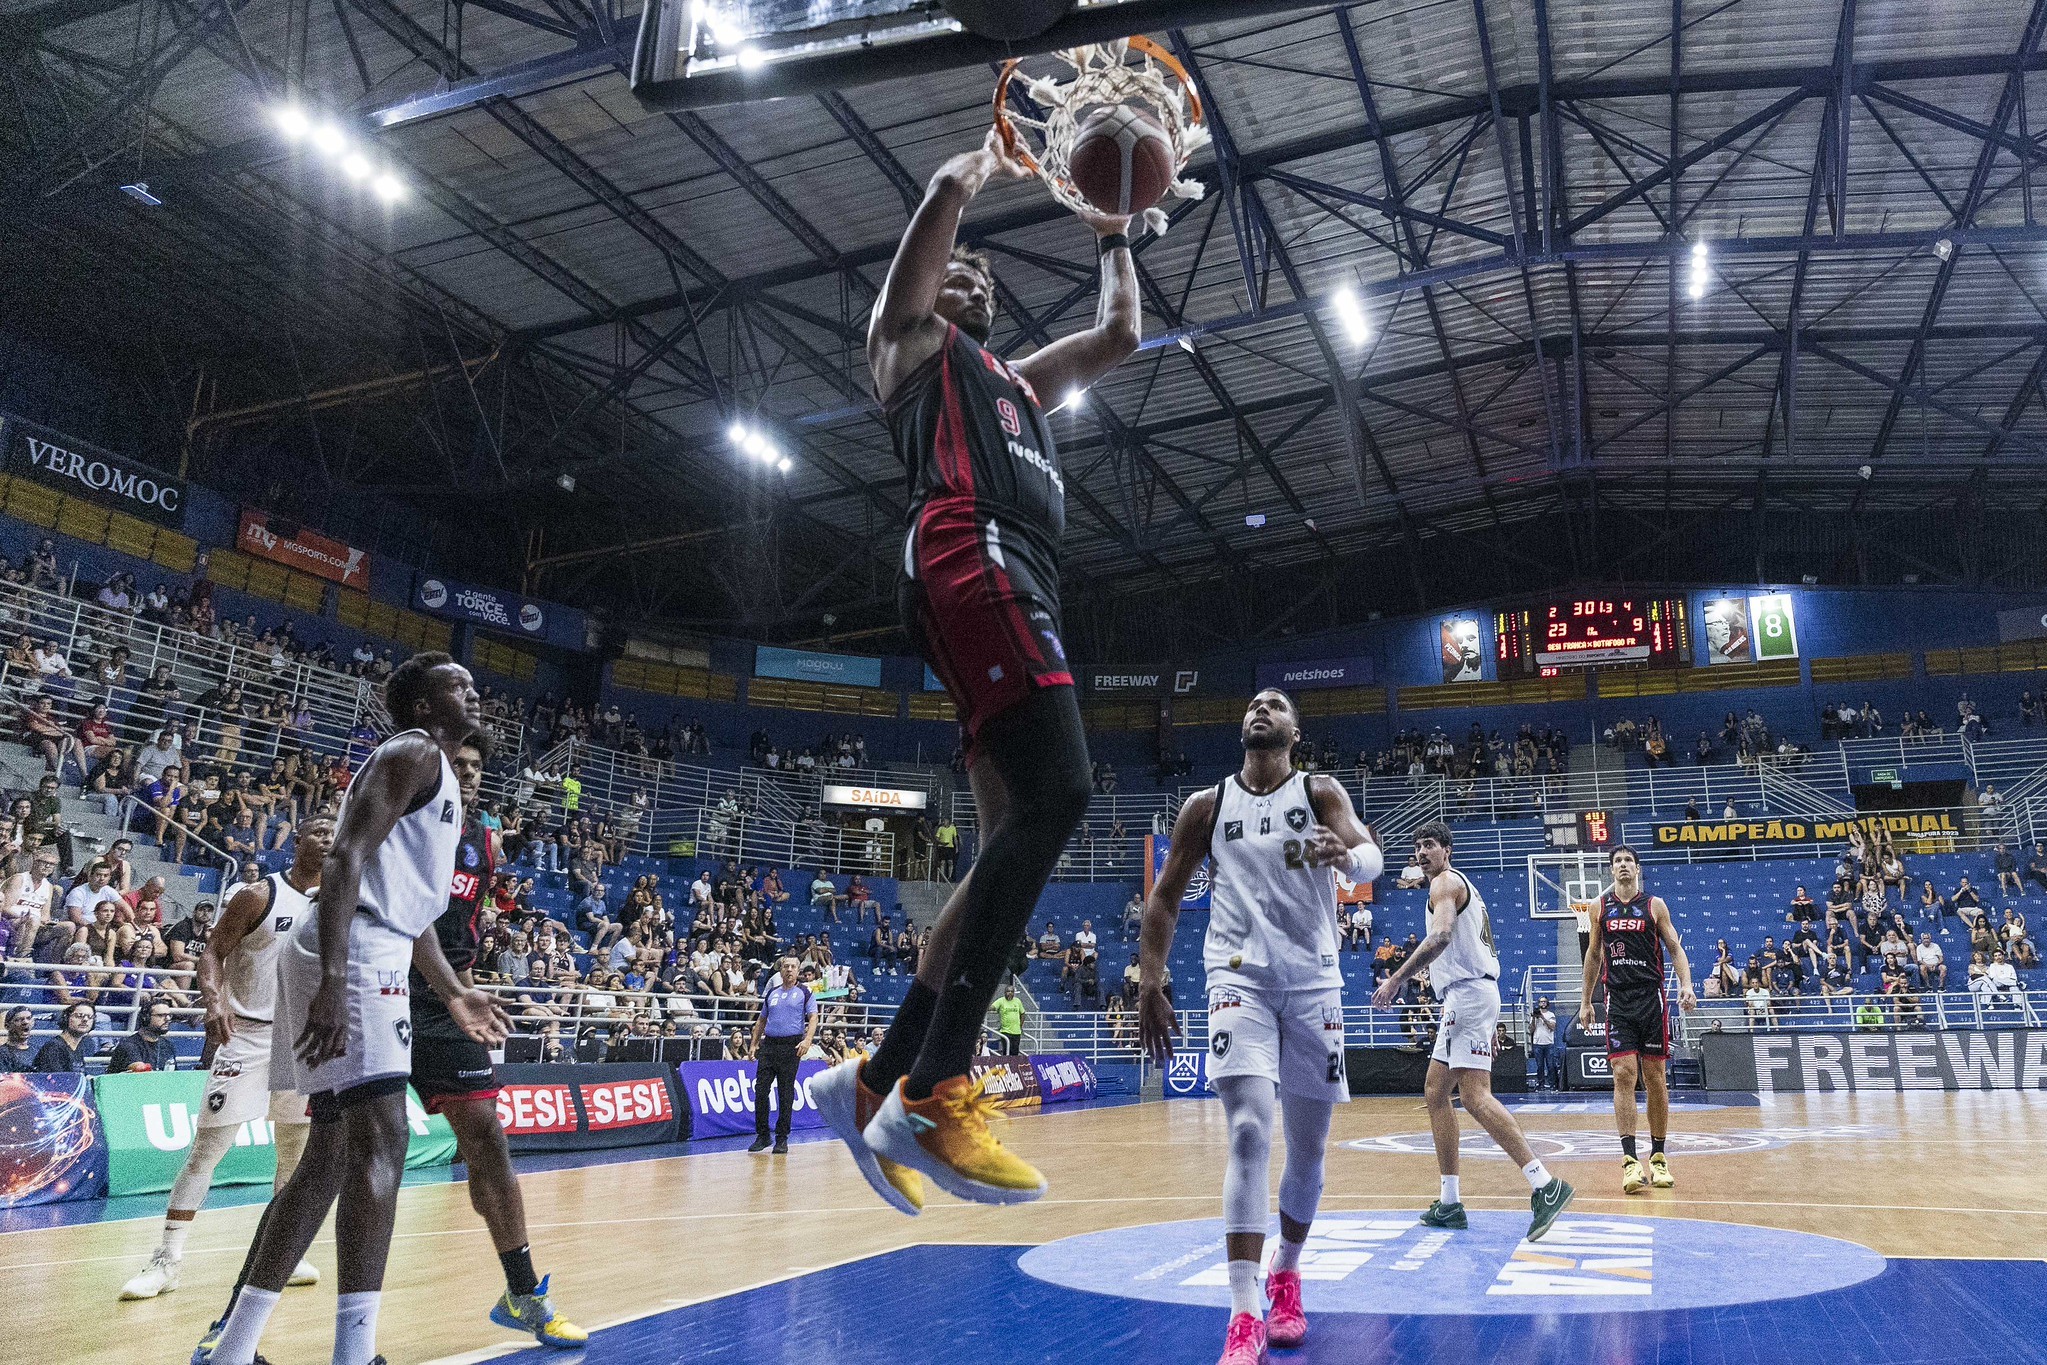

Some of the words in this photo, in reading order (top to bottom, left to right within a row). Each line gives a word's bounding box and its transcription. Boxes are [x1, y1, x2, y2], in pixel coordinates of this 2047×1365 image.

[996, 398, 1020, 436] 9
[27, 437, 178, 511] VEROMOC
[455, 593, 504, 616] TORCE
[1549, 607, 1557, 617] 2
[1623, 602, 1631, 611] 4
[1549, 622, 1567, 638] 23
[1633, 617, 1643, 631] 9
[1765, 614, 1783, 638] 8
[1095, 675, 1159, 687] FREEWAY
[1658, 820, 1806, 844] CAMPEÃO
[452, 874, 475, 898] SI
[1609, 919, 1641, 931] SESI
[1589, 1057, 1608, 1069] Q2
[496, 1088, 567, 1128] SESI
[590, 1082, 662, 1125] SESI
